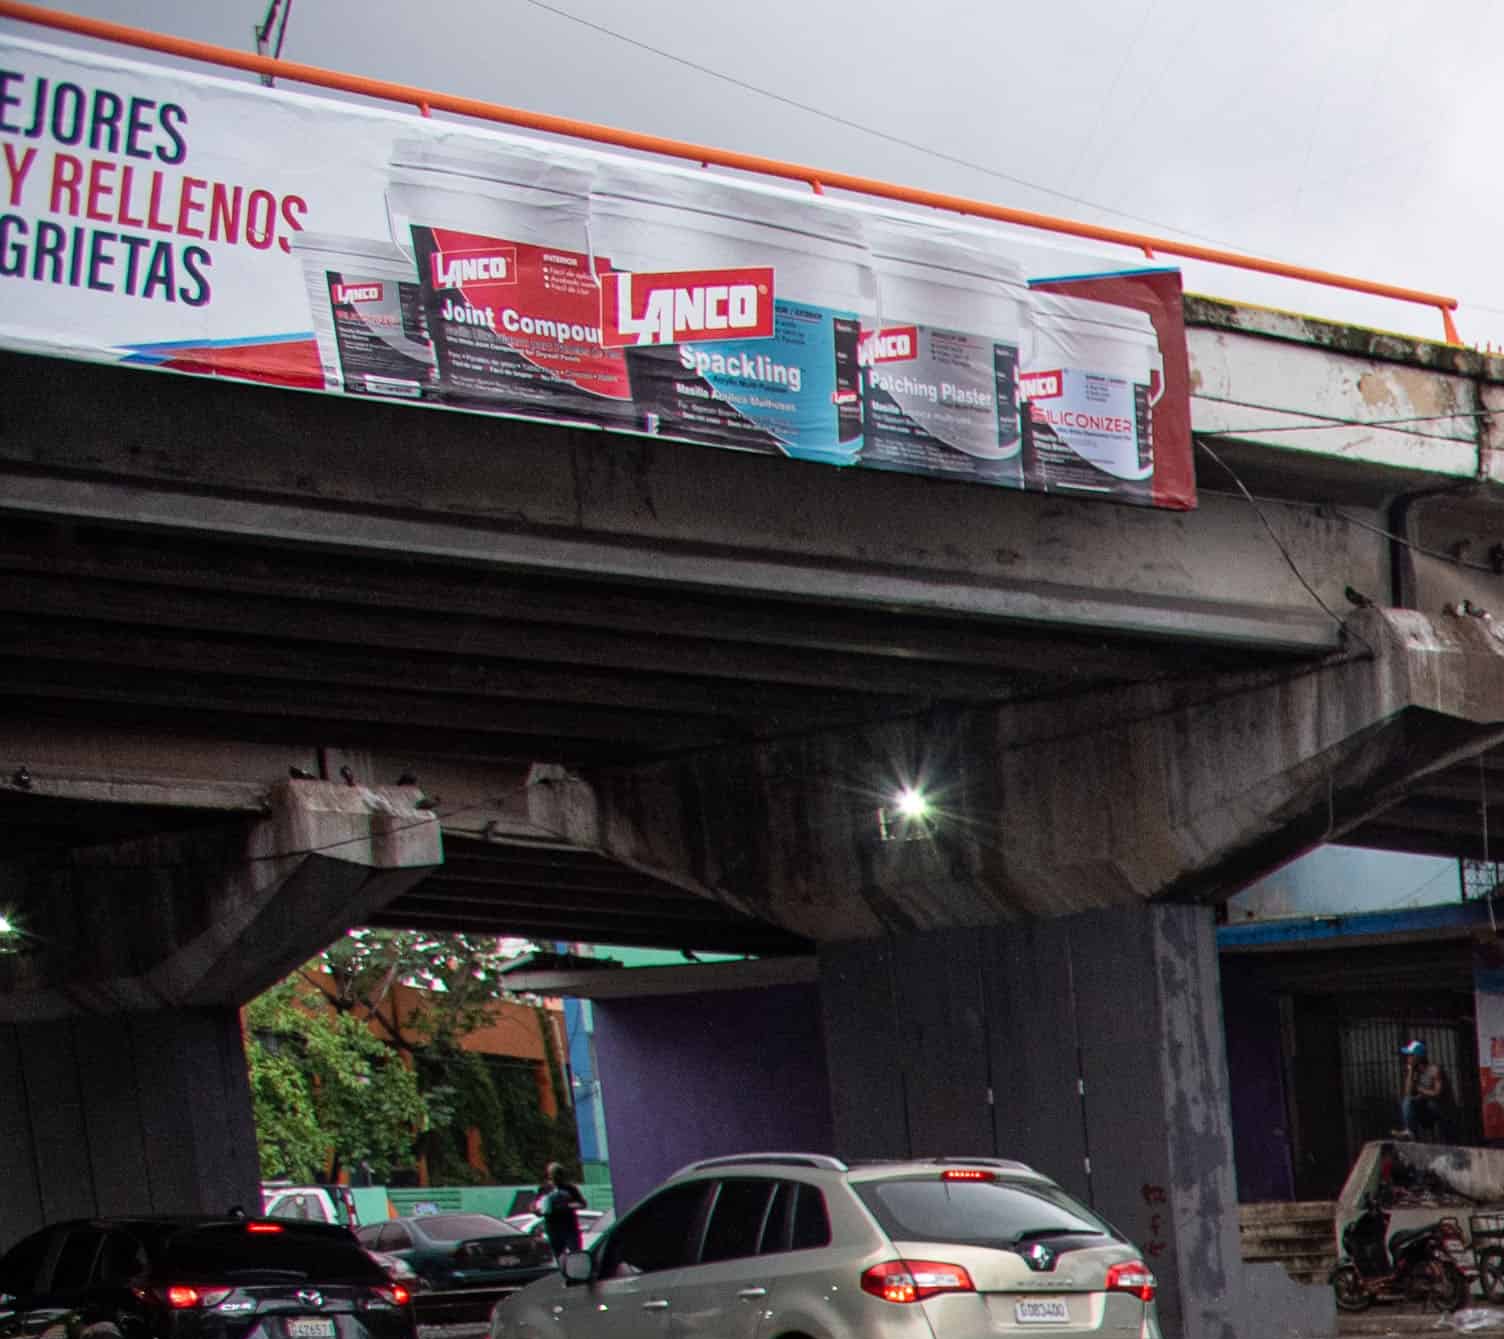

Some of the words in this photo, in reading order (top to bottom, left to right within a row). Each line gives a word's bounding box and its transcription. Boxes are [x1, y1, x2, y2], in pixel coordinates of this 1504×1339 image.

[3, 143, 37, 206] Y
[49, 152, 309, 254] RELLENOS
[0, 214, 213, 307] GRIETAS
[434, 248, 509, 288] LANCO
[442, 299, 496, 329] Joint
[616, 272, 759, 345] LANCO
[680, 344, 801, 392] Spackling
[941, 382, 993, 405] Plaster
